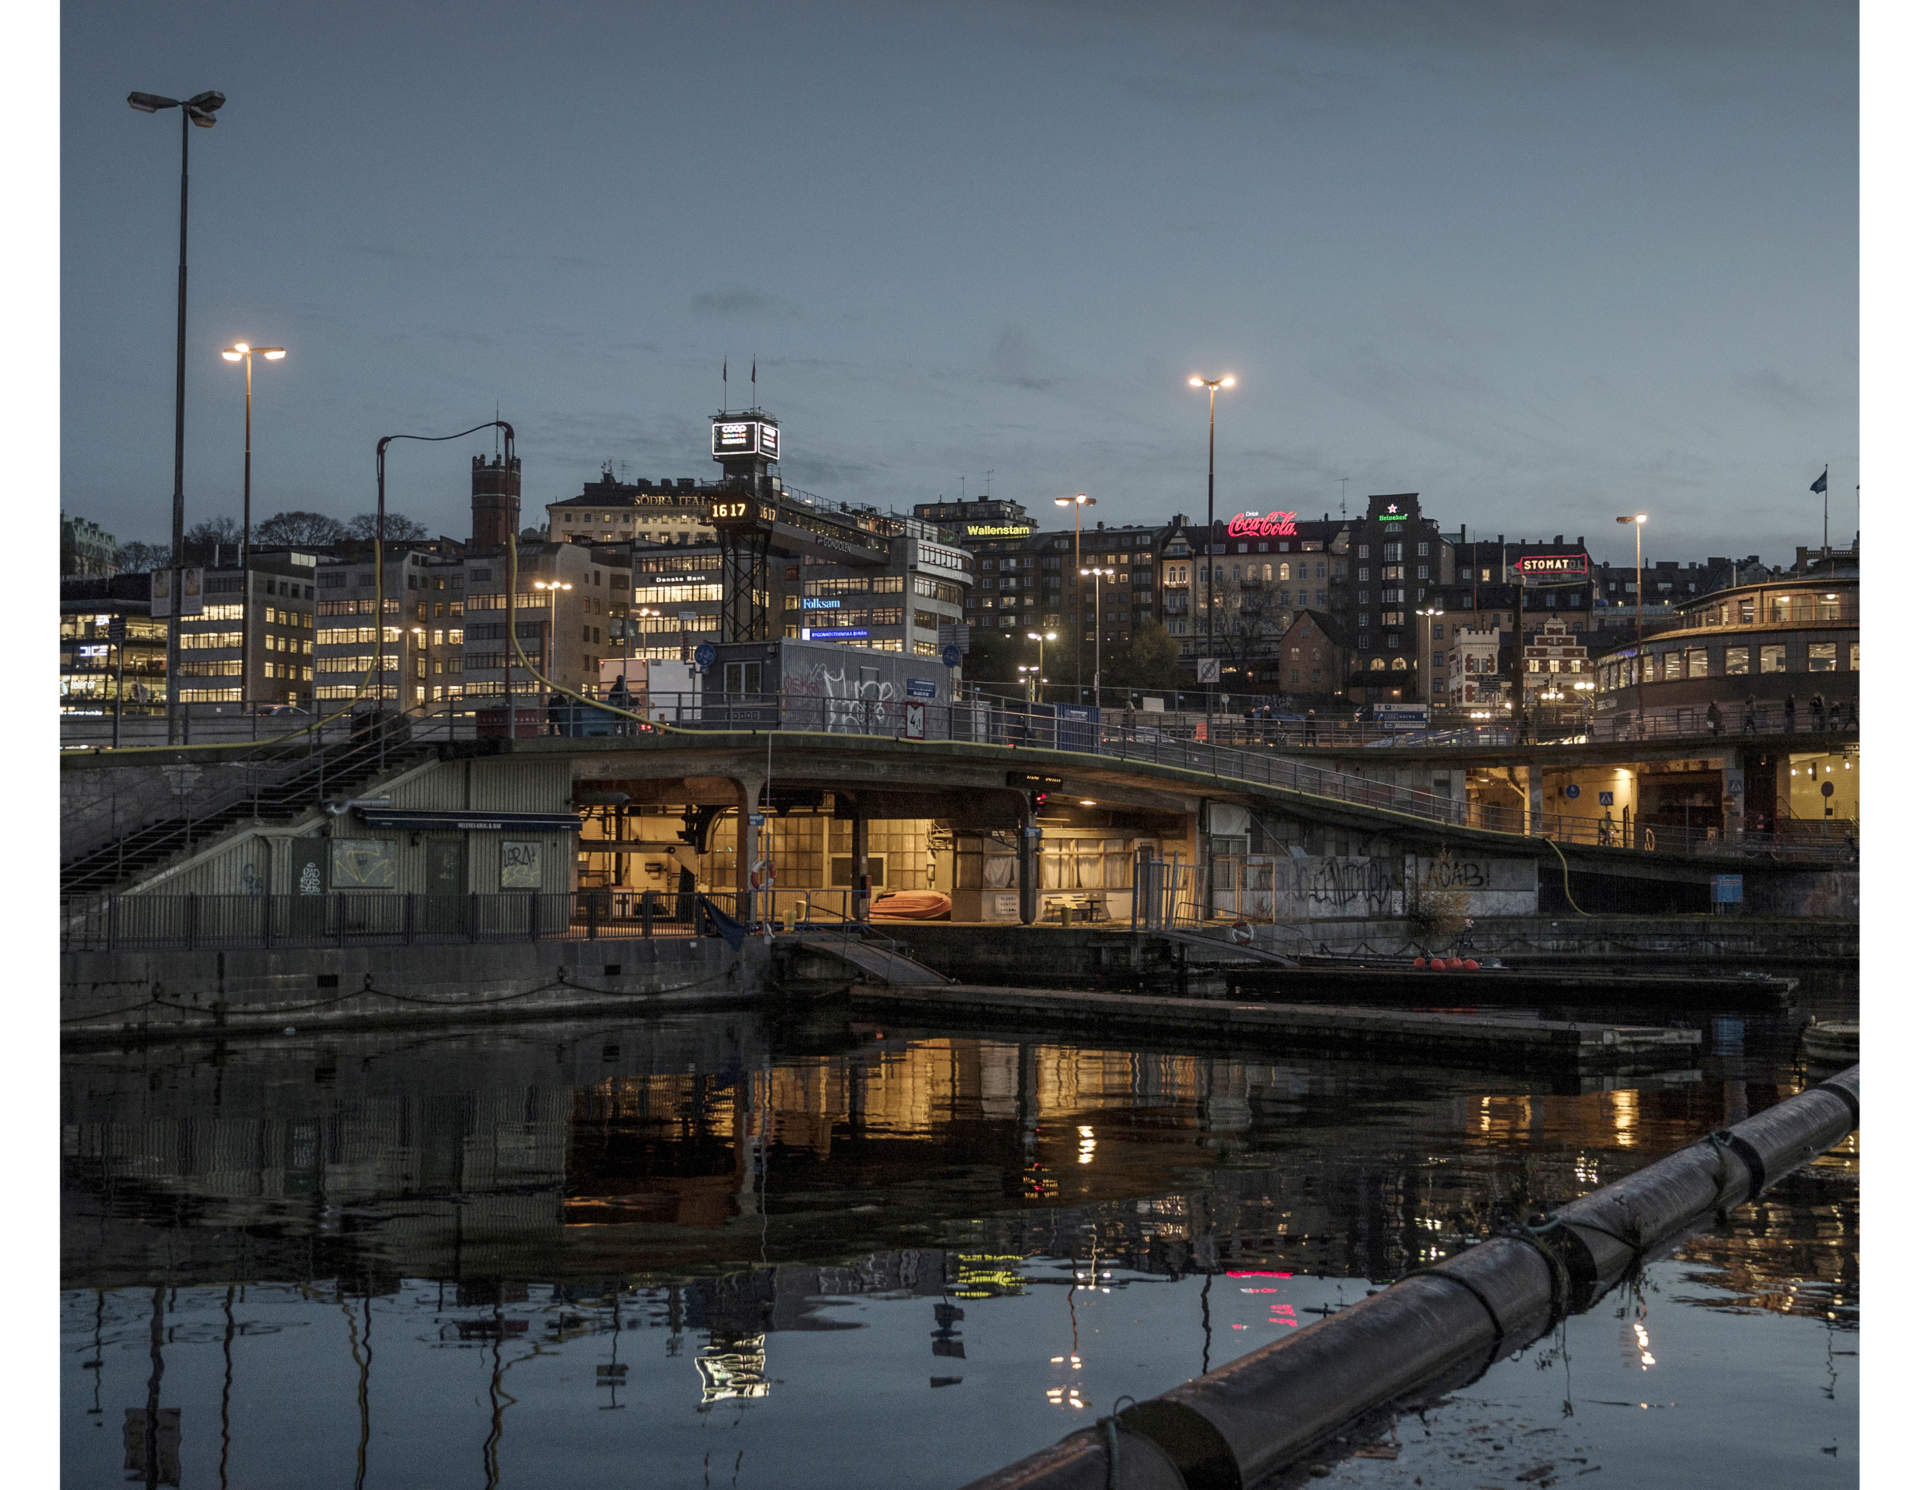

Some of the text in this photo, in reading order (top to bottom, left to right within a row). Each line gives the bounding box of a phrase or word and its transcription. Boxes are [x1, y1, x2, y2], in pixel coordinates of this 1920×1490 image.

[634, 493, 673, 506] SÖDRA
[1378, 514, 1408, 522] Heineken
[967, 525, 1030, 535] Wallenstam
[1229, 512, 1296, 537] Coca-Cola
[803, 597, 841, 609] Folksam
[80, 645, 108, 656] DICE
